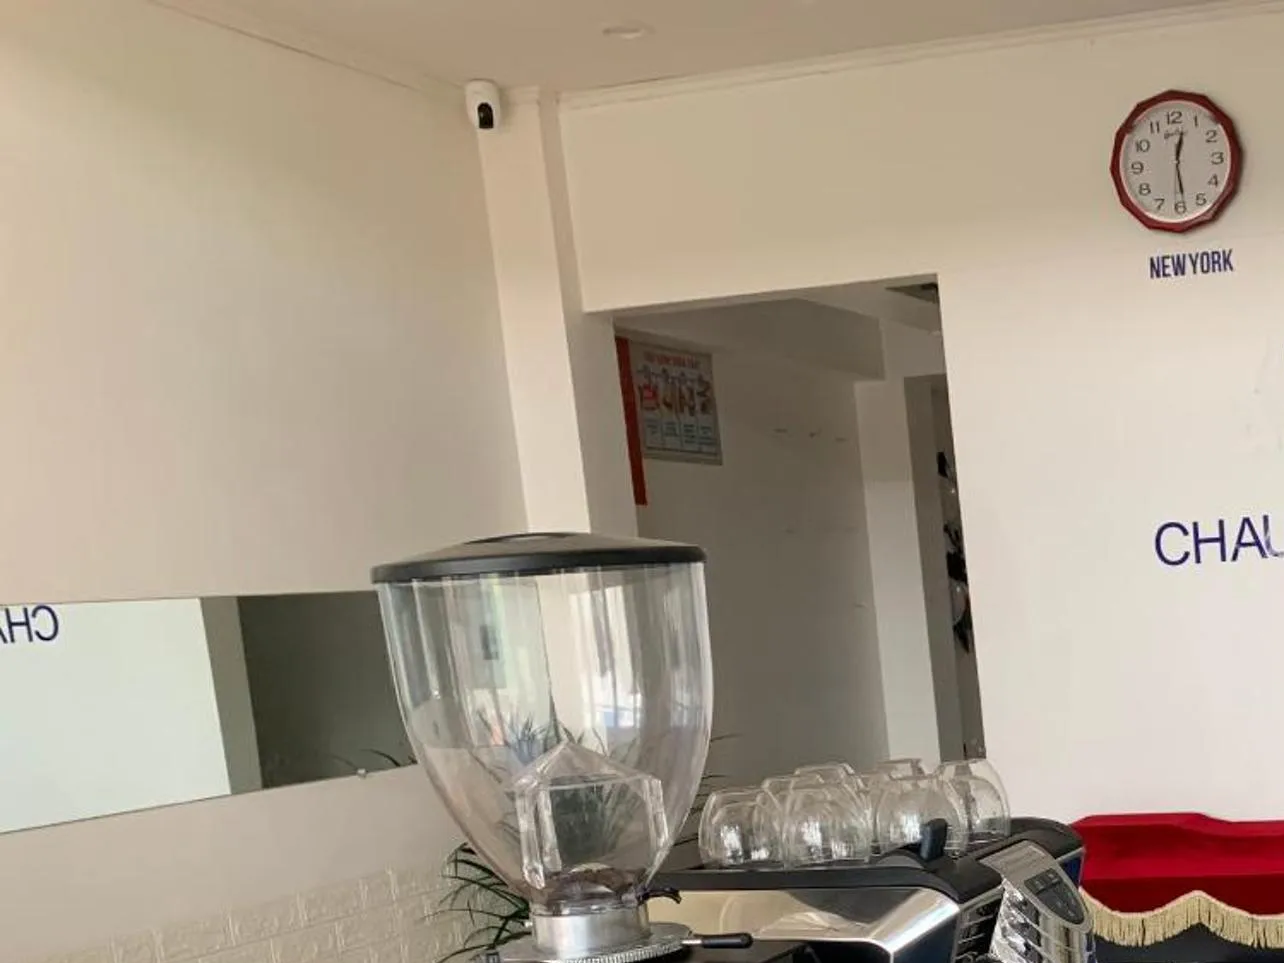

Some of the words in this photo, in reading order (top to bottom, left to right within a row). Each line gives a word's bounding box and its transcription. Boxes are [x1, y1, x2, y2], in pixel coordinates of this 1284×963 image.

[1166, 111, 1183, 125] 12
[1150, 121, 1160, 134] 11
[1205, 129, 1218, 143] 2
[1135, 139, 1151, 153] 10
[1211, 151, 1224, 165] 3
[1131, 161, 1144, 175] 9
[1208, 174, 1219, 188] 4
[1138, 182, 1151, 196] 8
[1154, 198, 1165, 210] 7
[1195, 192, 1207, 206] 5
[1174, 200, 1187, 214] 6
